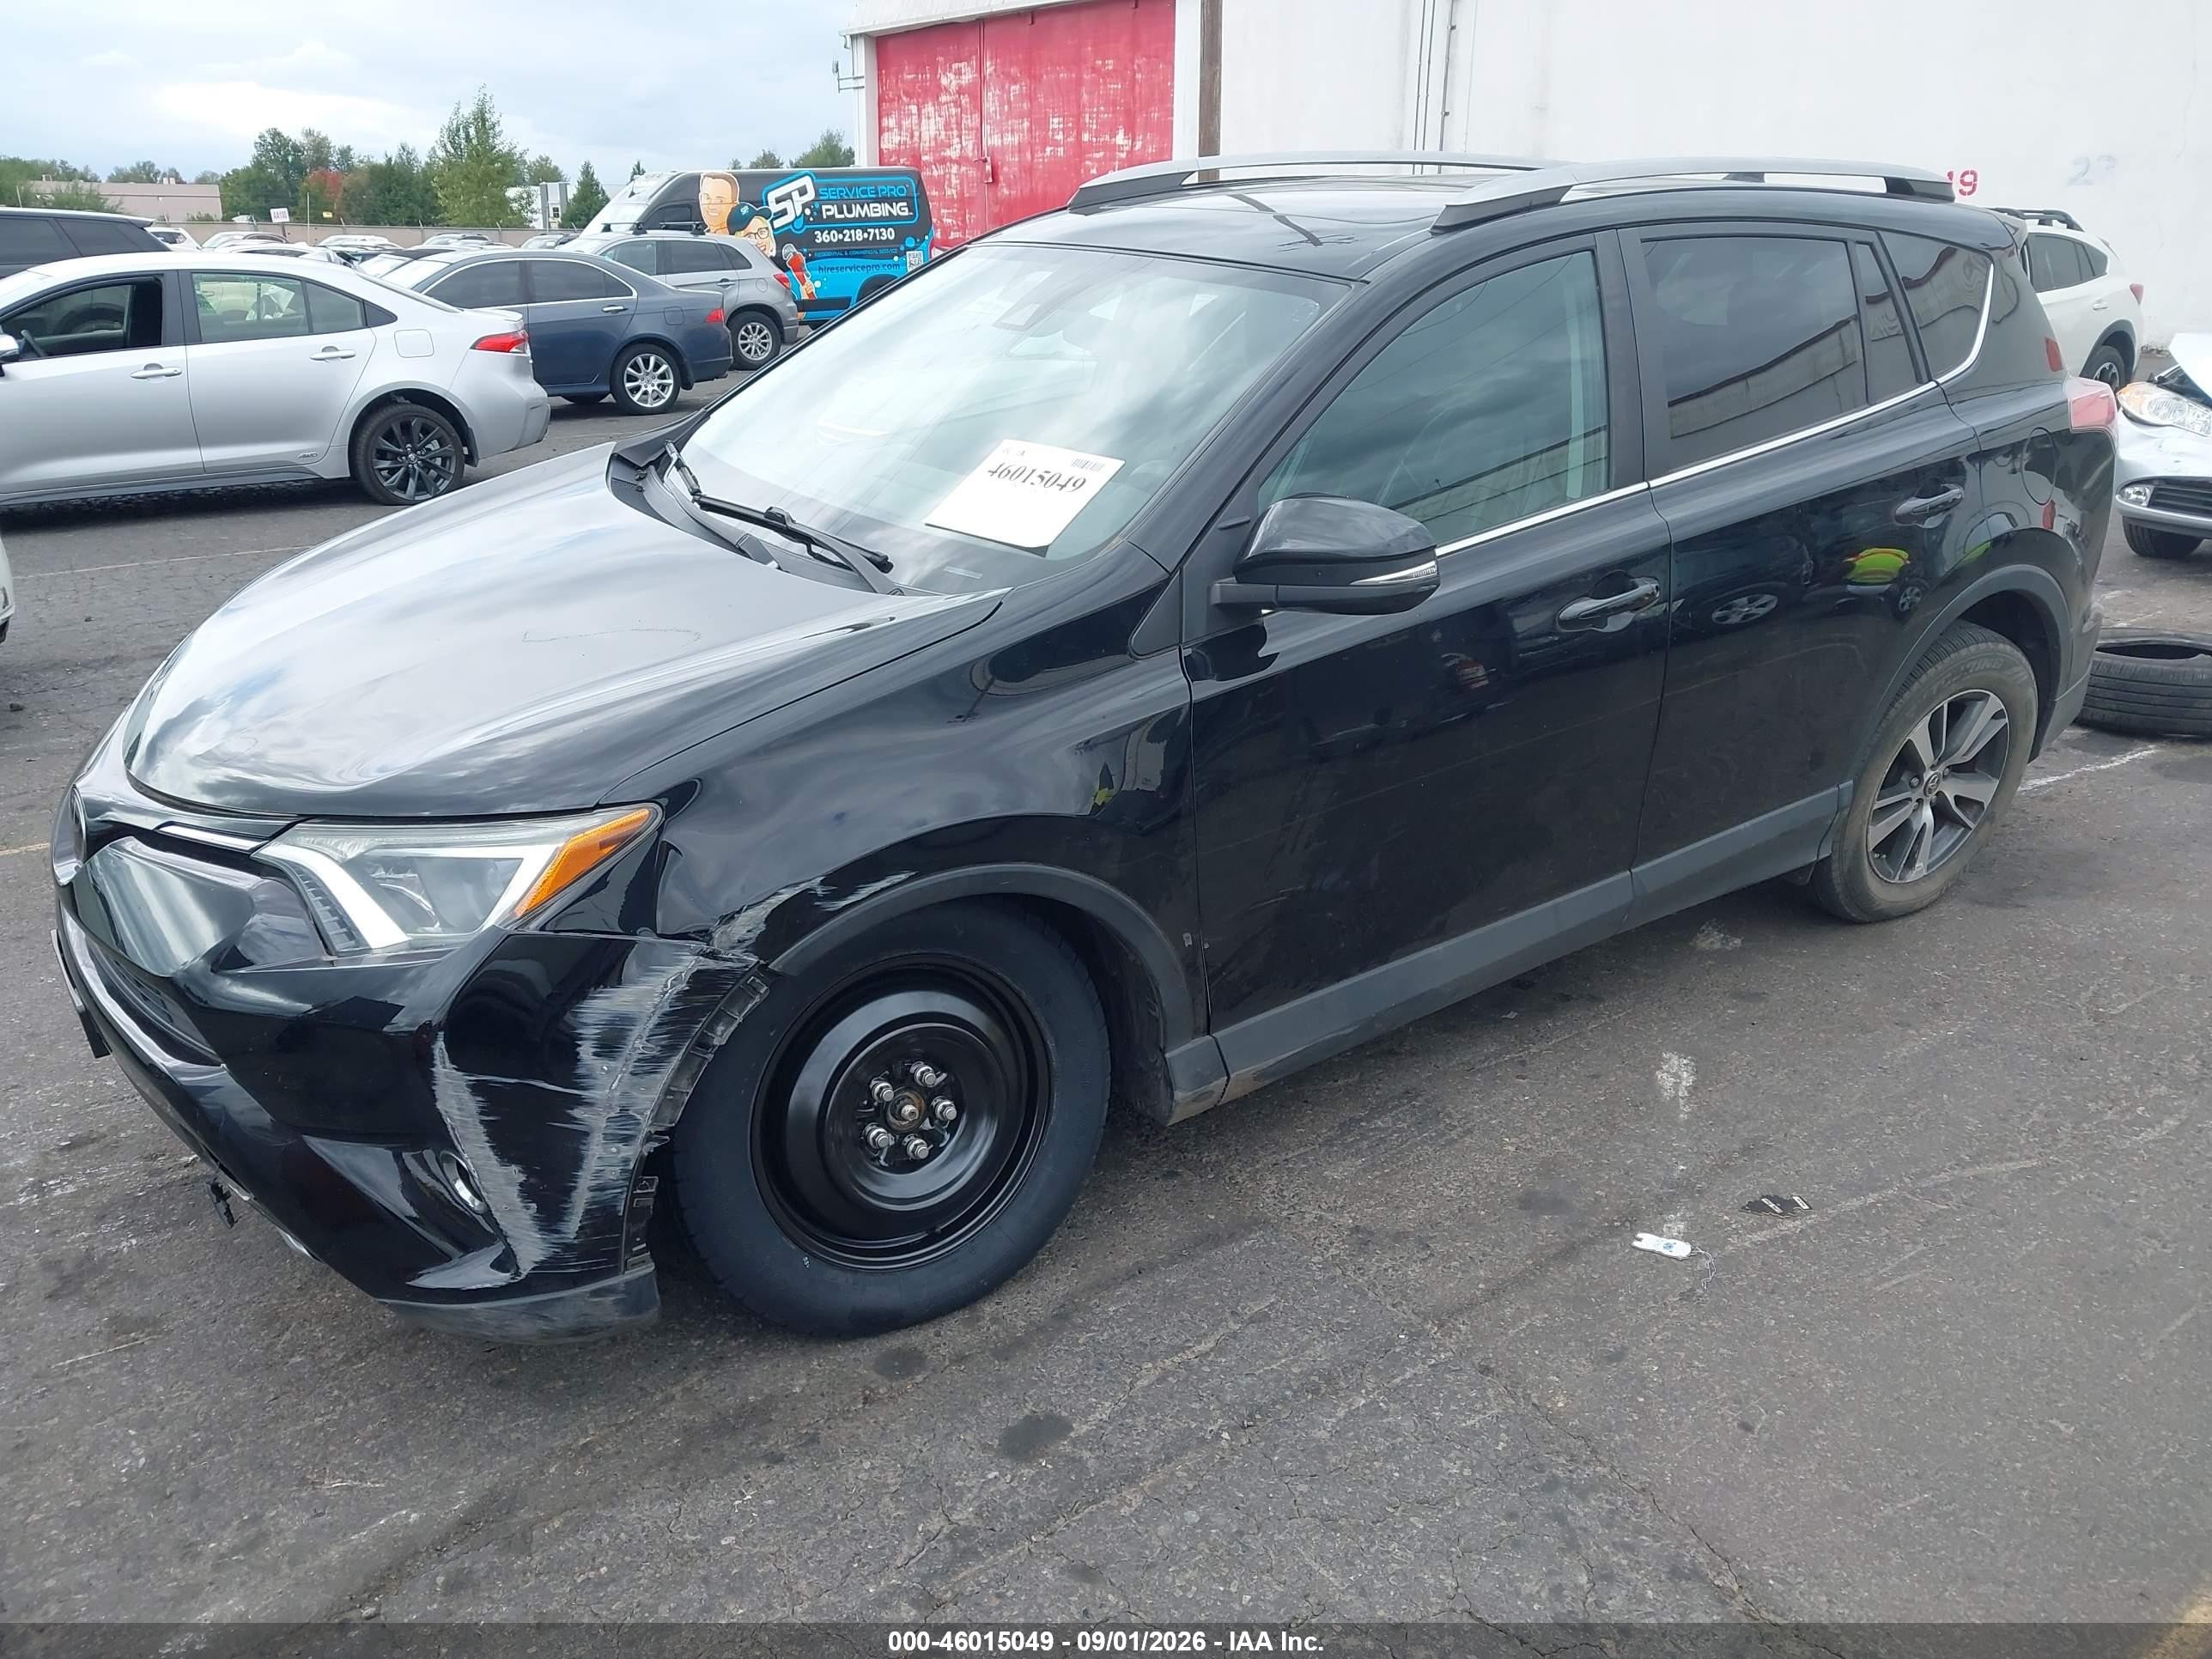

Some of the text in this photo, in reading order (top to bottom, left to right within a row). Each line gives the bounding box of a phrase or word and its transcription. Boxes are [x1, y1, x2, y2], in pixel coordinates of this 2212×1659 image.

[819, 185, 907, 199] SERVICE PRO
[767, 175, 816, 228] SP
[822, 202, 909, 219] PLUMBING
[817, 262, 900, 274] hireservicepro.com
[987, 462, 1087, 493] 46015049
